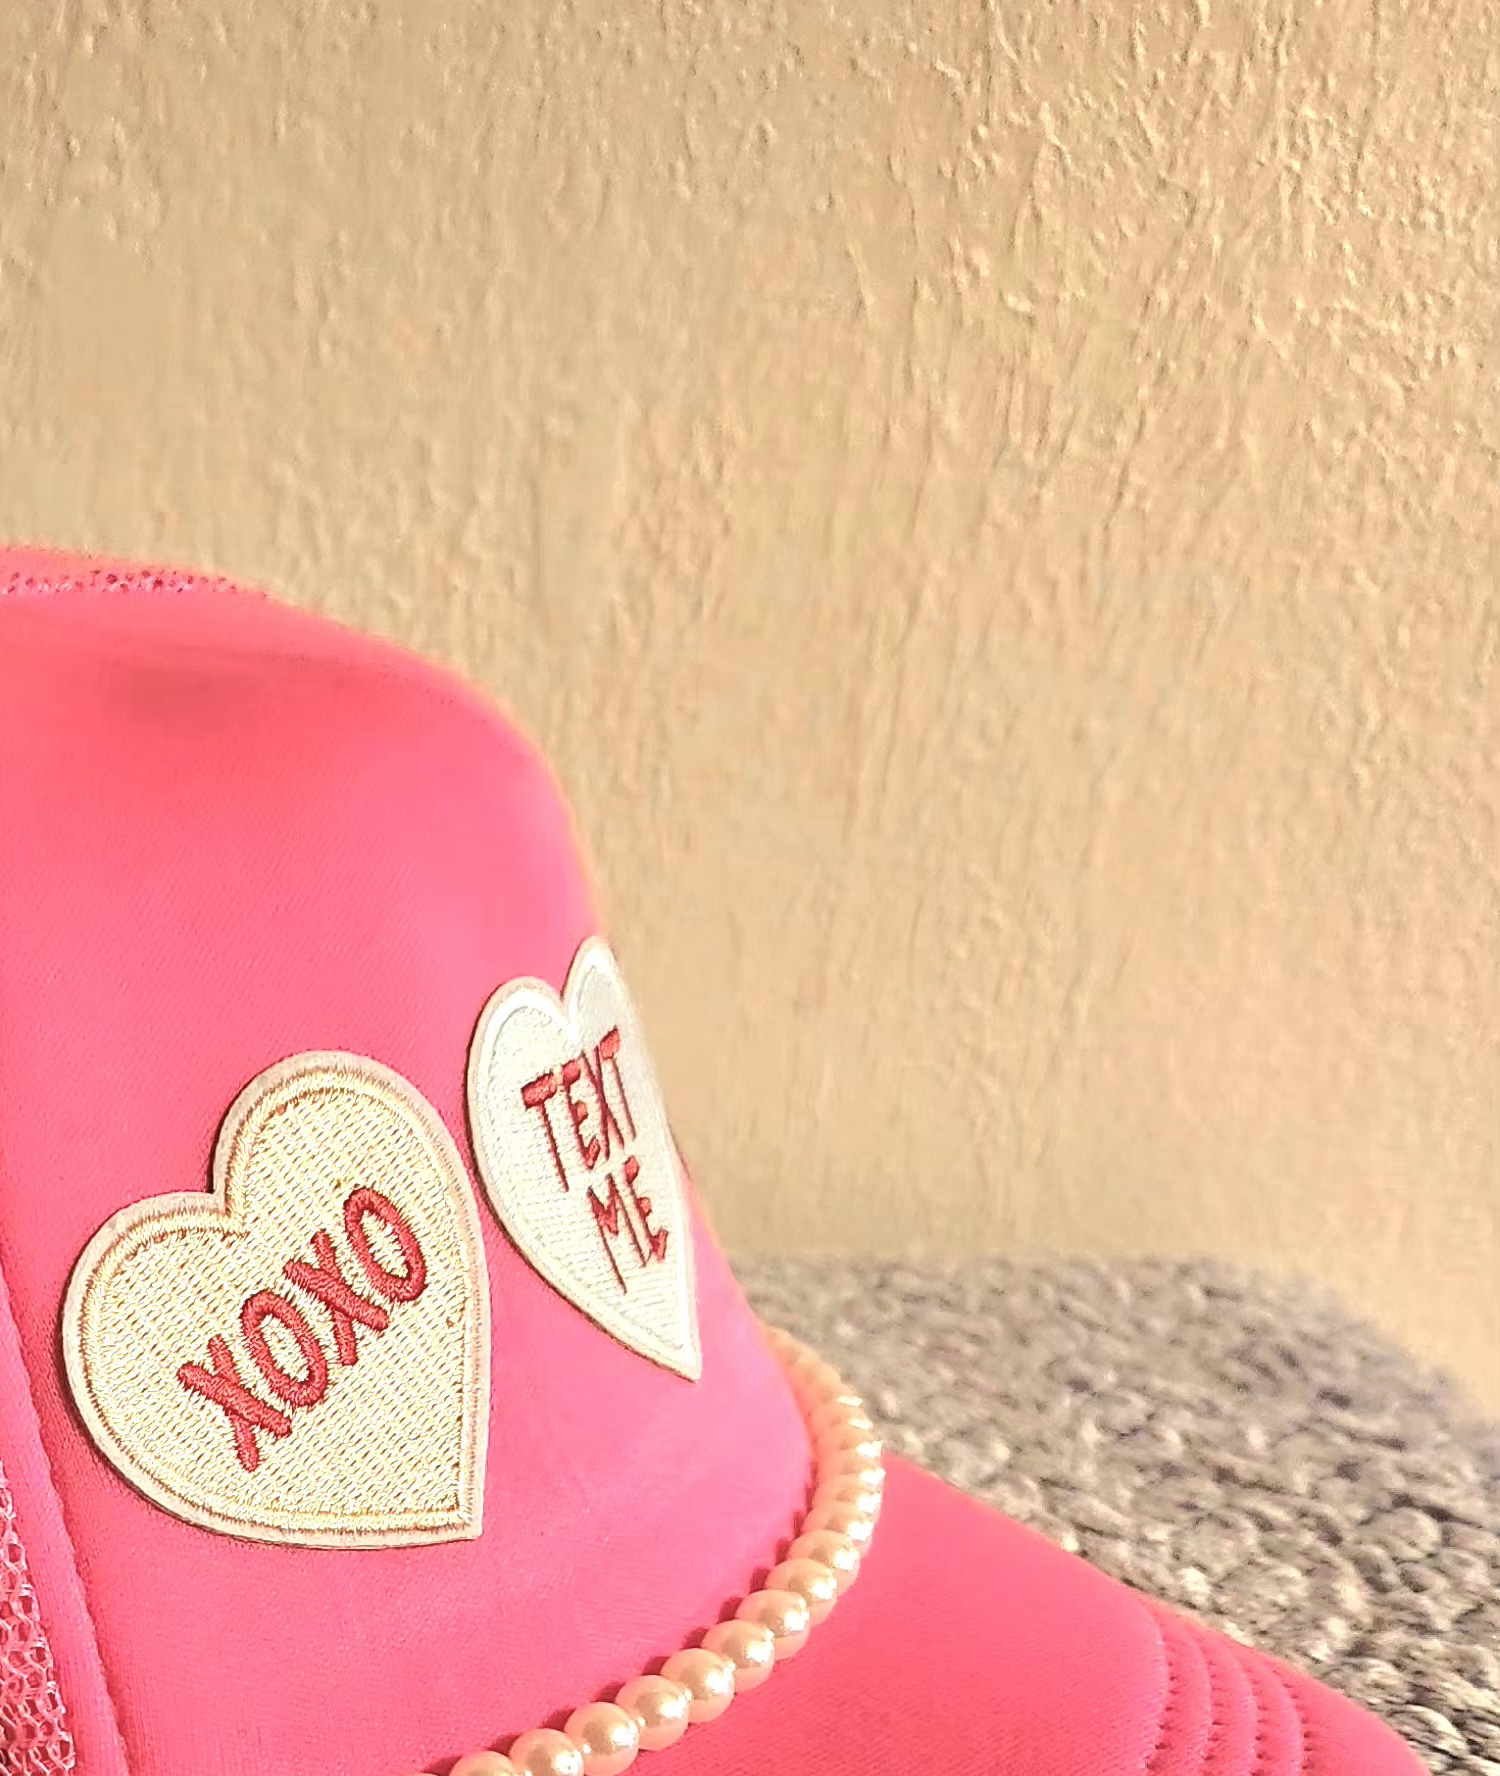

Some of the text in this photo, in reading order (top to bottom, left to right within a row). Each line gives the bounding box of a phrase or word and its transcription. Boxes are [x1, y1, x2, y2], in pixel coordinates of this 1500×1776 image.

[521, 1026, 636, 1191] TEXT
[586, 1157, 668, 1294] ME
[177, 1186, 427, 1472] XOXO
